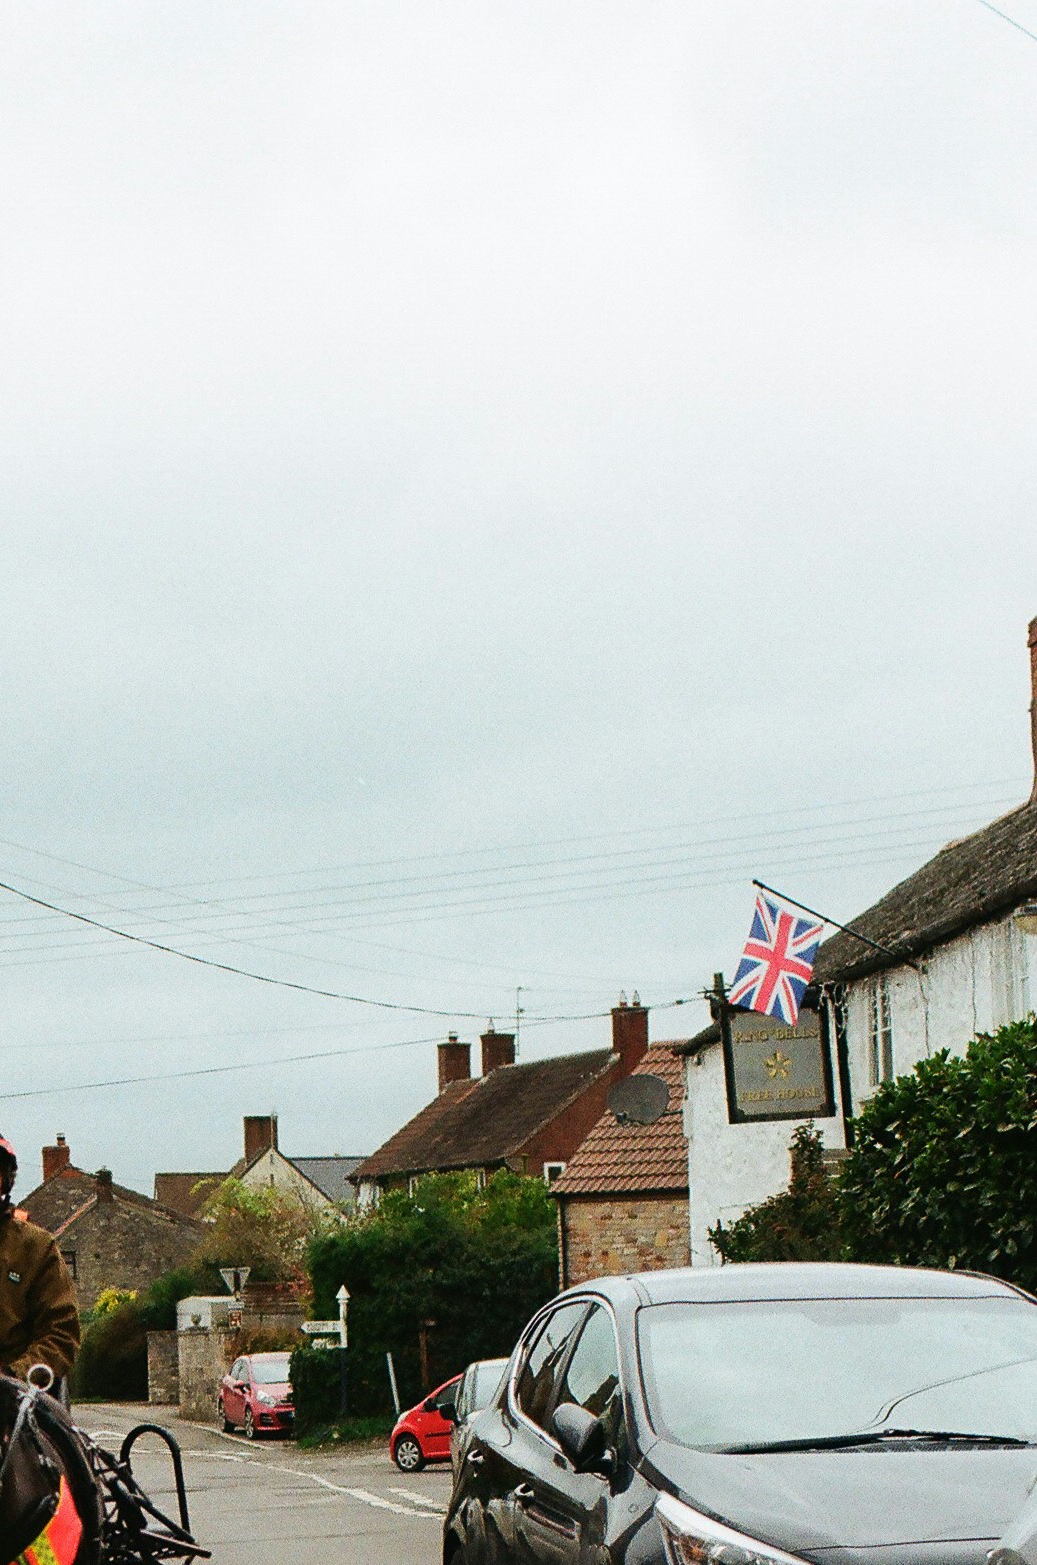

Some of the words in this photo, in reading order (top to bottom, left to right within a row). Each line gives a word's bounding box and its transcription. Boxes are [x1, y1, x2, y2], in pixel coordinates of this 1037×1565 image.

[776, 1026, 819, 1040] BELLS
[740, 1089, 770, 1101] FREE
[777, 1087, 819, 1100] HOUSE
